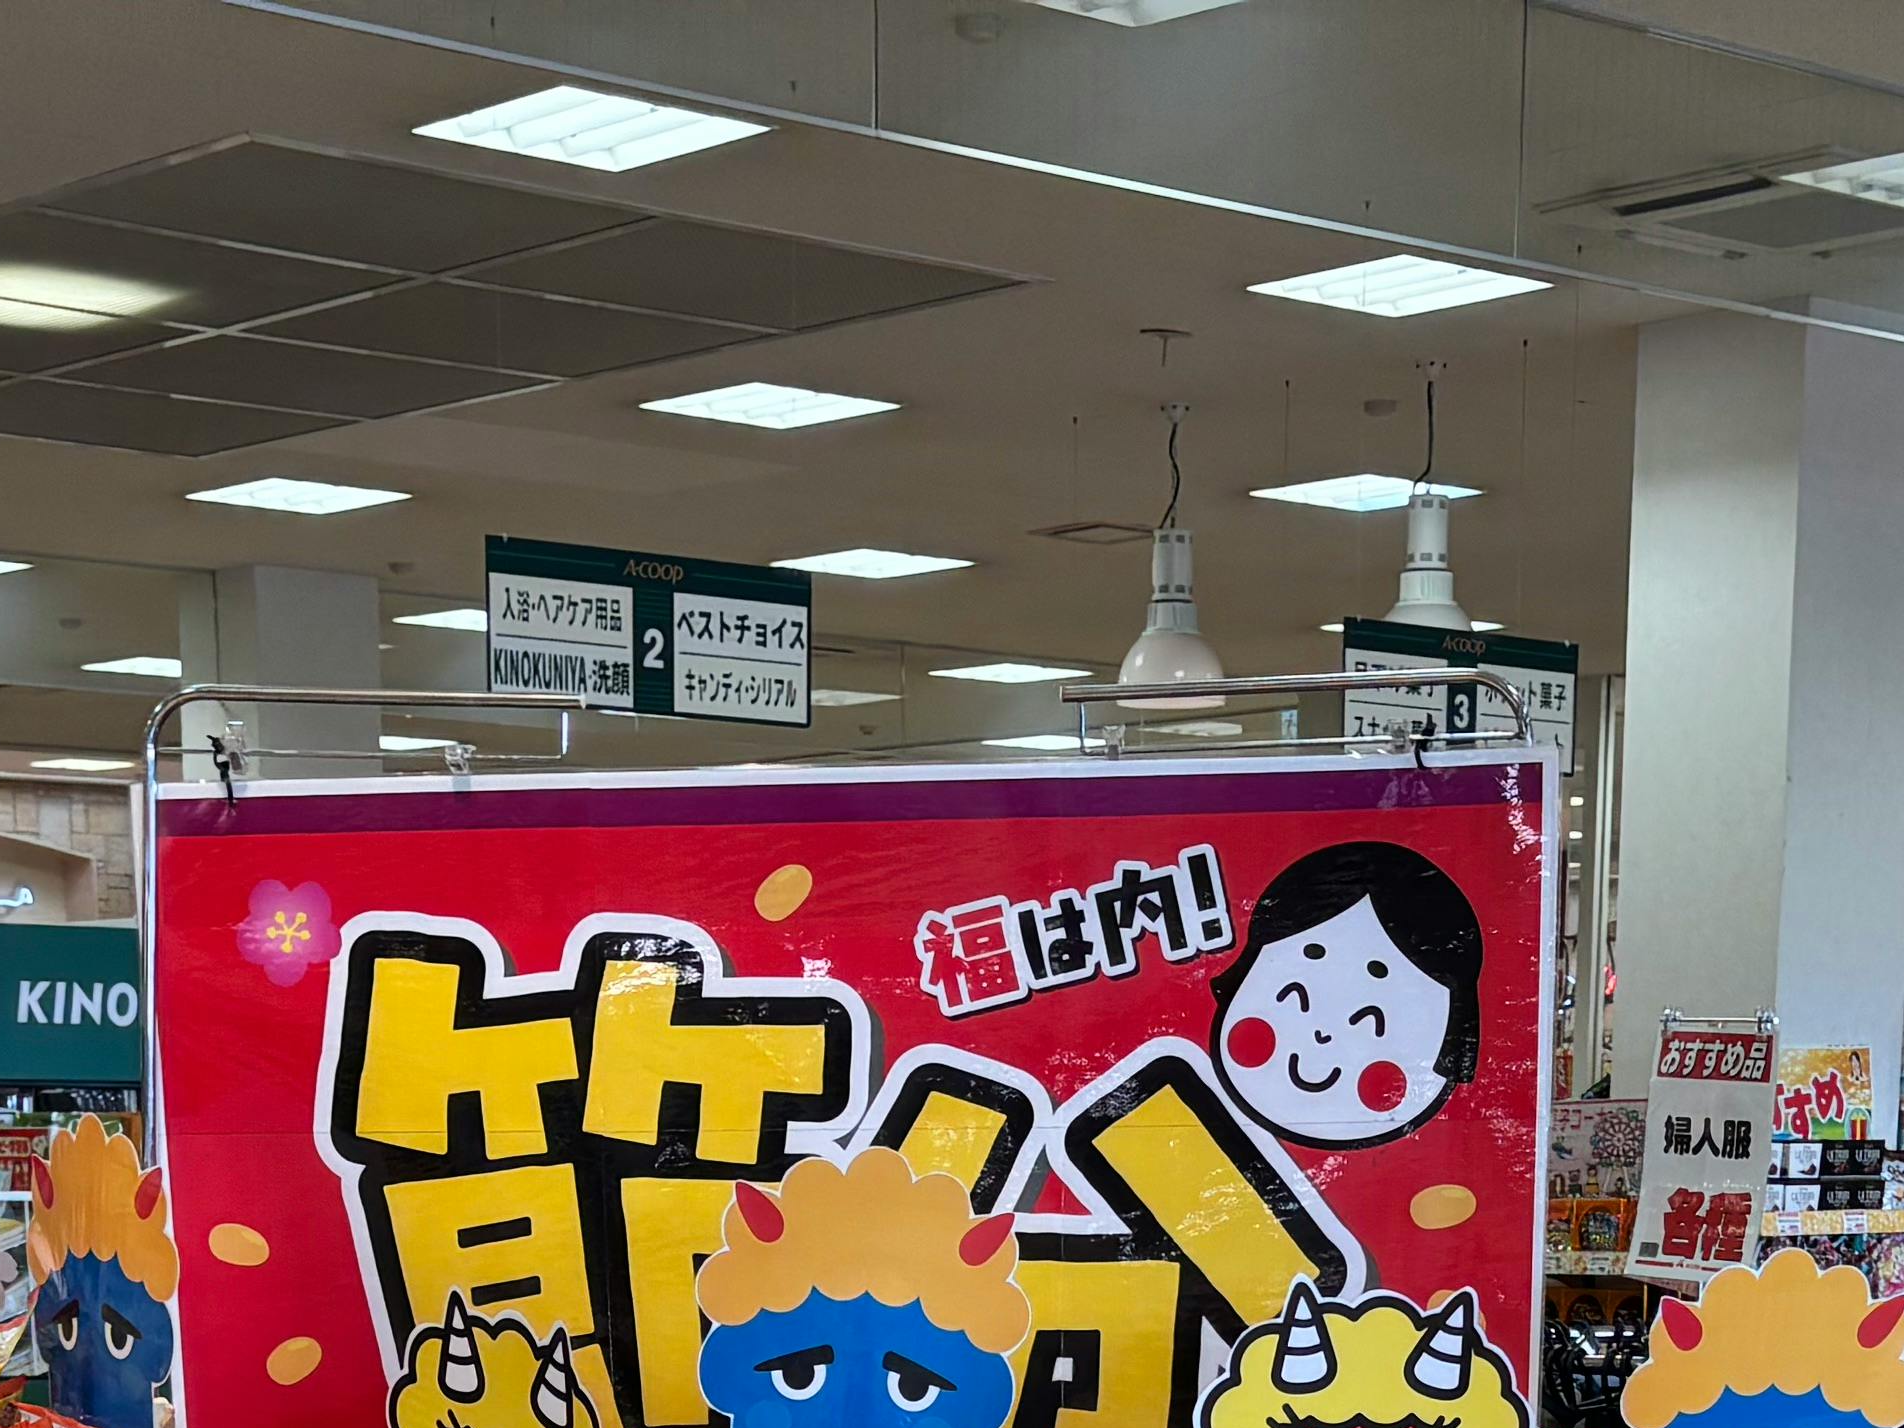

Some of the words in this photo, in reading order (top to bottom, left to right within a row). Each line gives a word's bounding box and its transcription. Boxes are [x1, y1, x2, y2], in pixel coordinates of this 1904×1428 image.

[502, 587, 622, 633] 入浴・ヘアケア用品
[677, 609, 805, 651] ベストチョイス
[643, 628, 664, 669] 2
[1453, 694, 1470, 729] 3
[916, 843, 1236, 1016] 福は内!
[1659, 1036, 1770, 1081] おすすめ品
[1663, 1115, 1753, 1161] 婦人服
[1662, 1187, 1754, 1263] 各種
